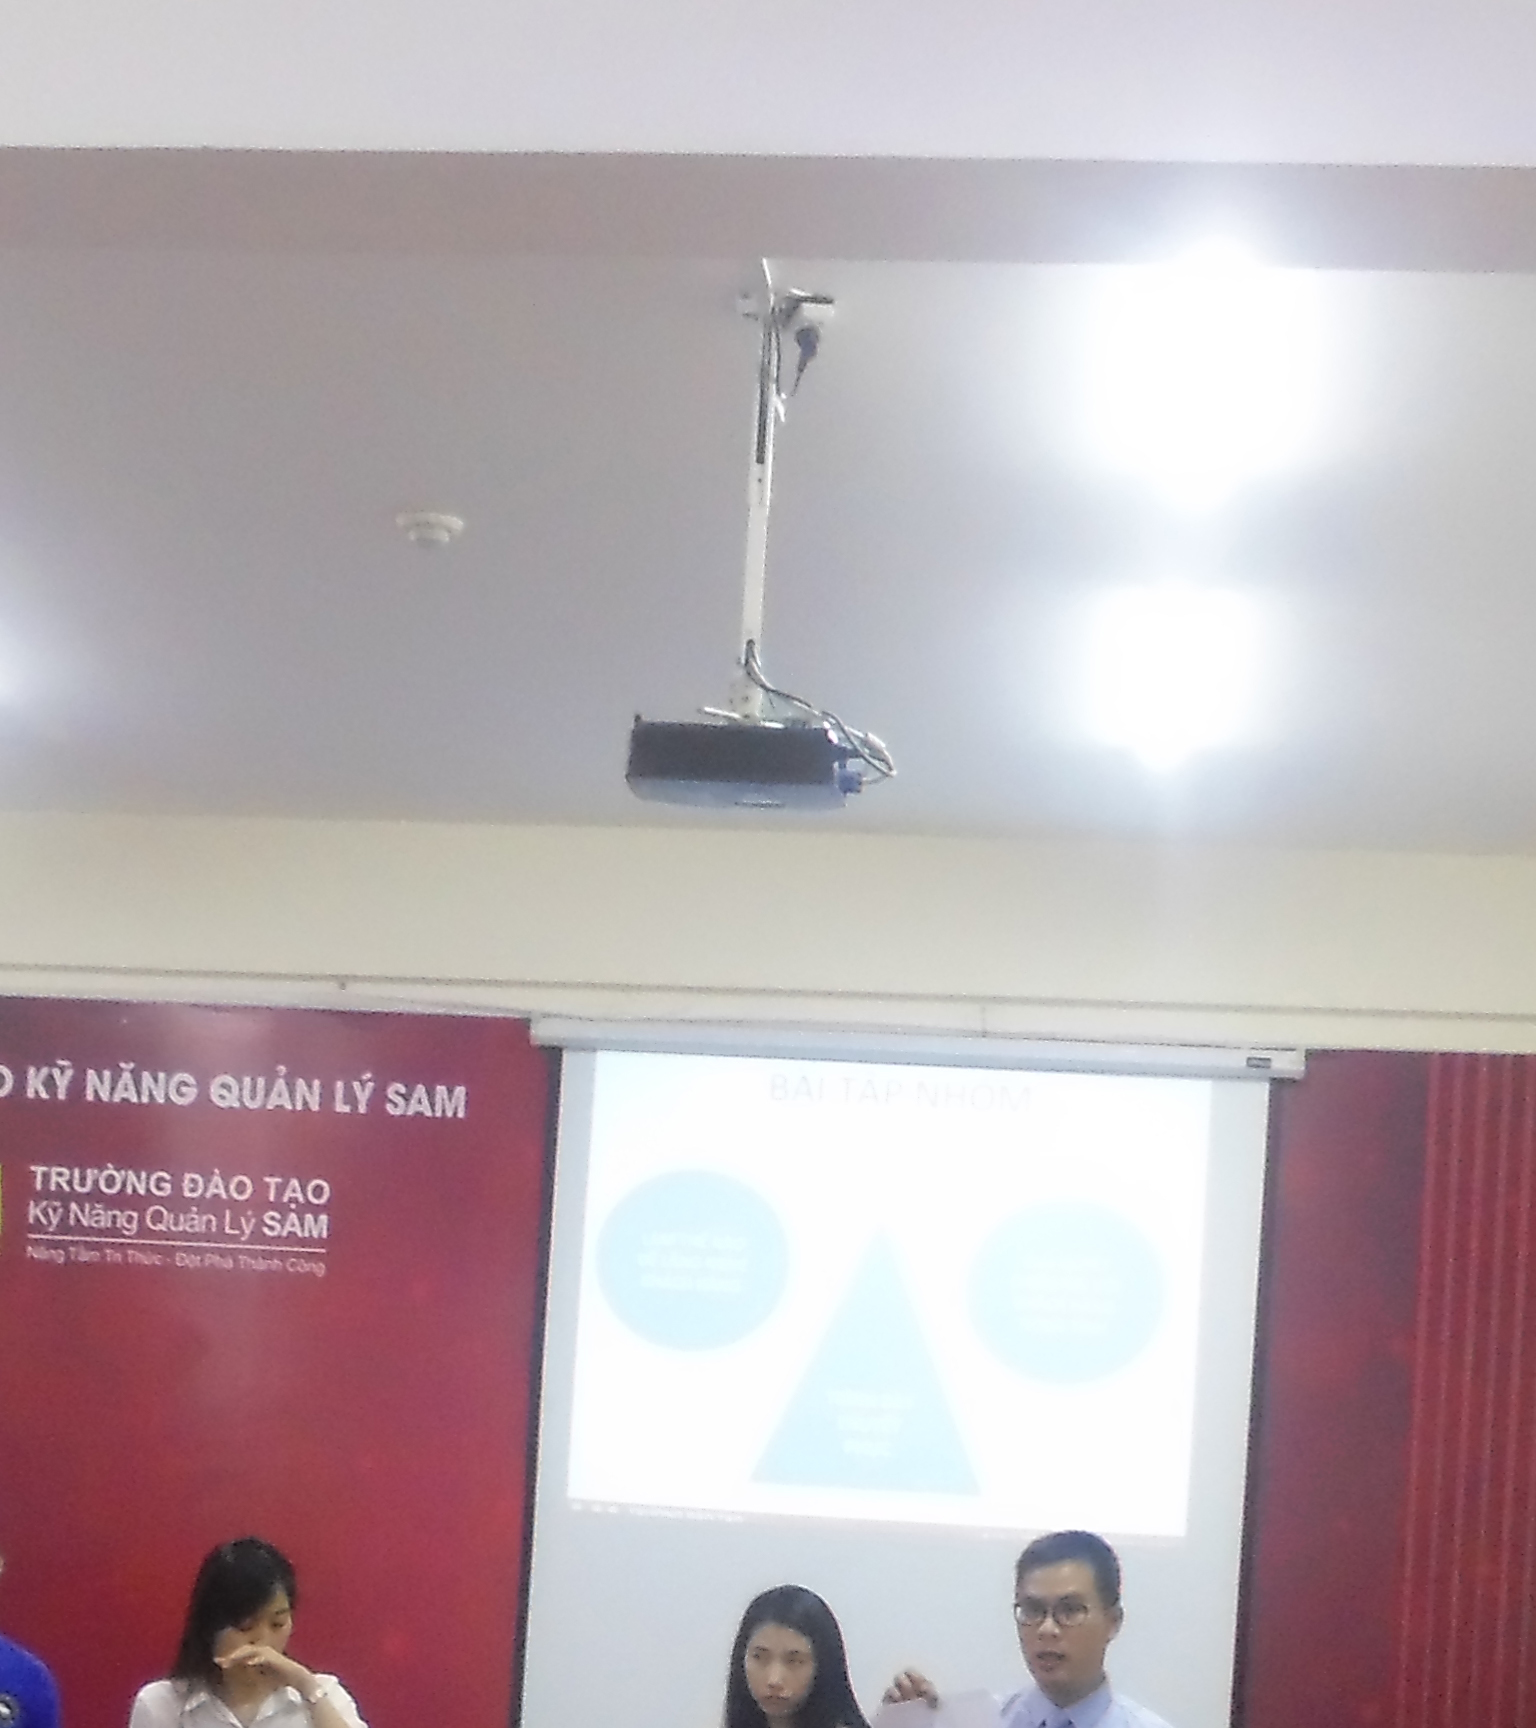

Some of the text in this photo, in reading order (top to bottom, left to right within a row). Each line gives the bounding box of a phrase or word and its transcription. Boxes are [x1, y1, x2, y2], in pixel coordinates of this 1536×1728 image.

[26, 1059, 75, 1100] KỸ
[85, 1061, 199, 1106] NĂNG
[209, 1065, 321, 1112] QUẢN
[333, 1072, 375, 1114] LÝ
[385, 1082, 467, 1118] SAM
[29, 1163, 331, 1209] TRƯỜNG ĐÀO TẠO
[27, 1200, 329, 1241] Kỹ Năng Quản Lý SAM
